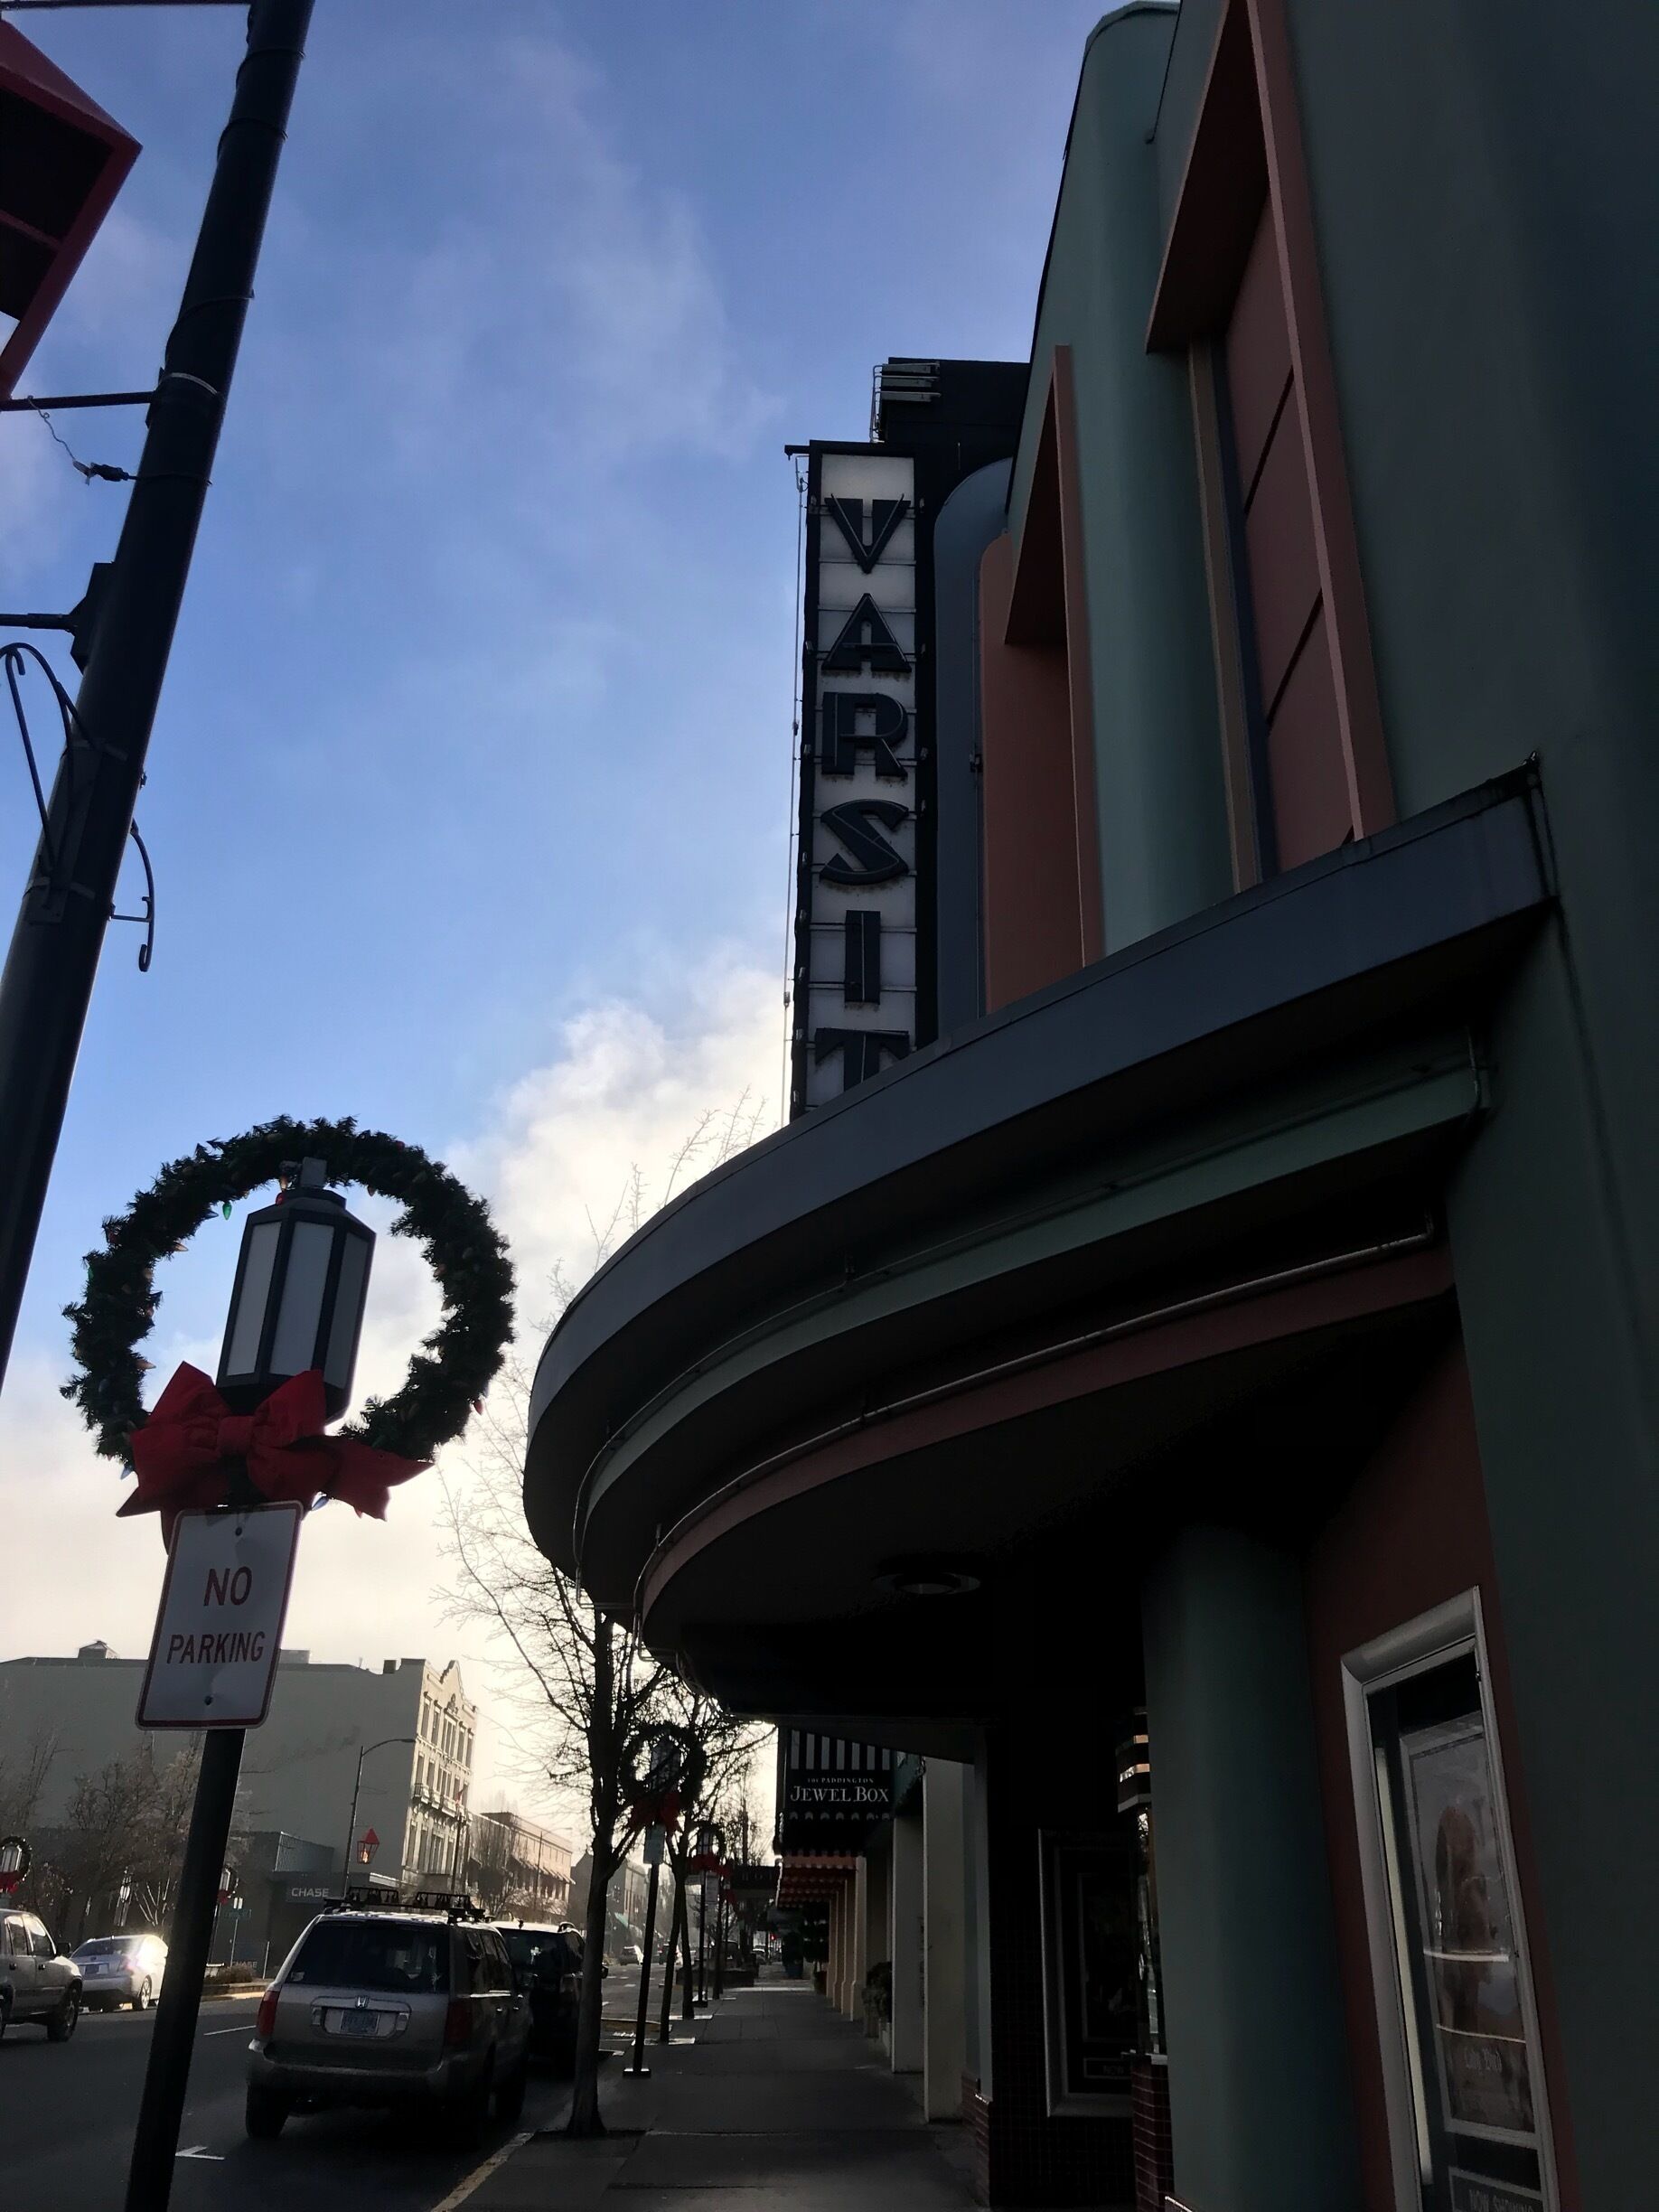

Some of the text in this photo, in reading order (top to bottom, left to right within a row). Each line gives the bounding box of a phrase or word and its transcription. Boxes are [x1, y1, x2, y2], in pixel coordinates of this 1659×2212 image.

[203, 1566, 253, 1607] NO
[166, 1631, 266, 1664] PARKING
[790, 1786, 889, 1803] JEWEL BOX
[291, 1887, 330, 1898] CHASE
